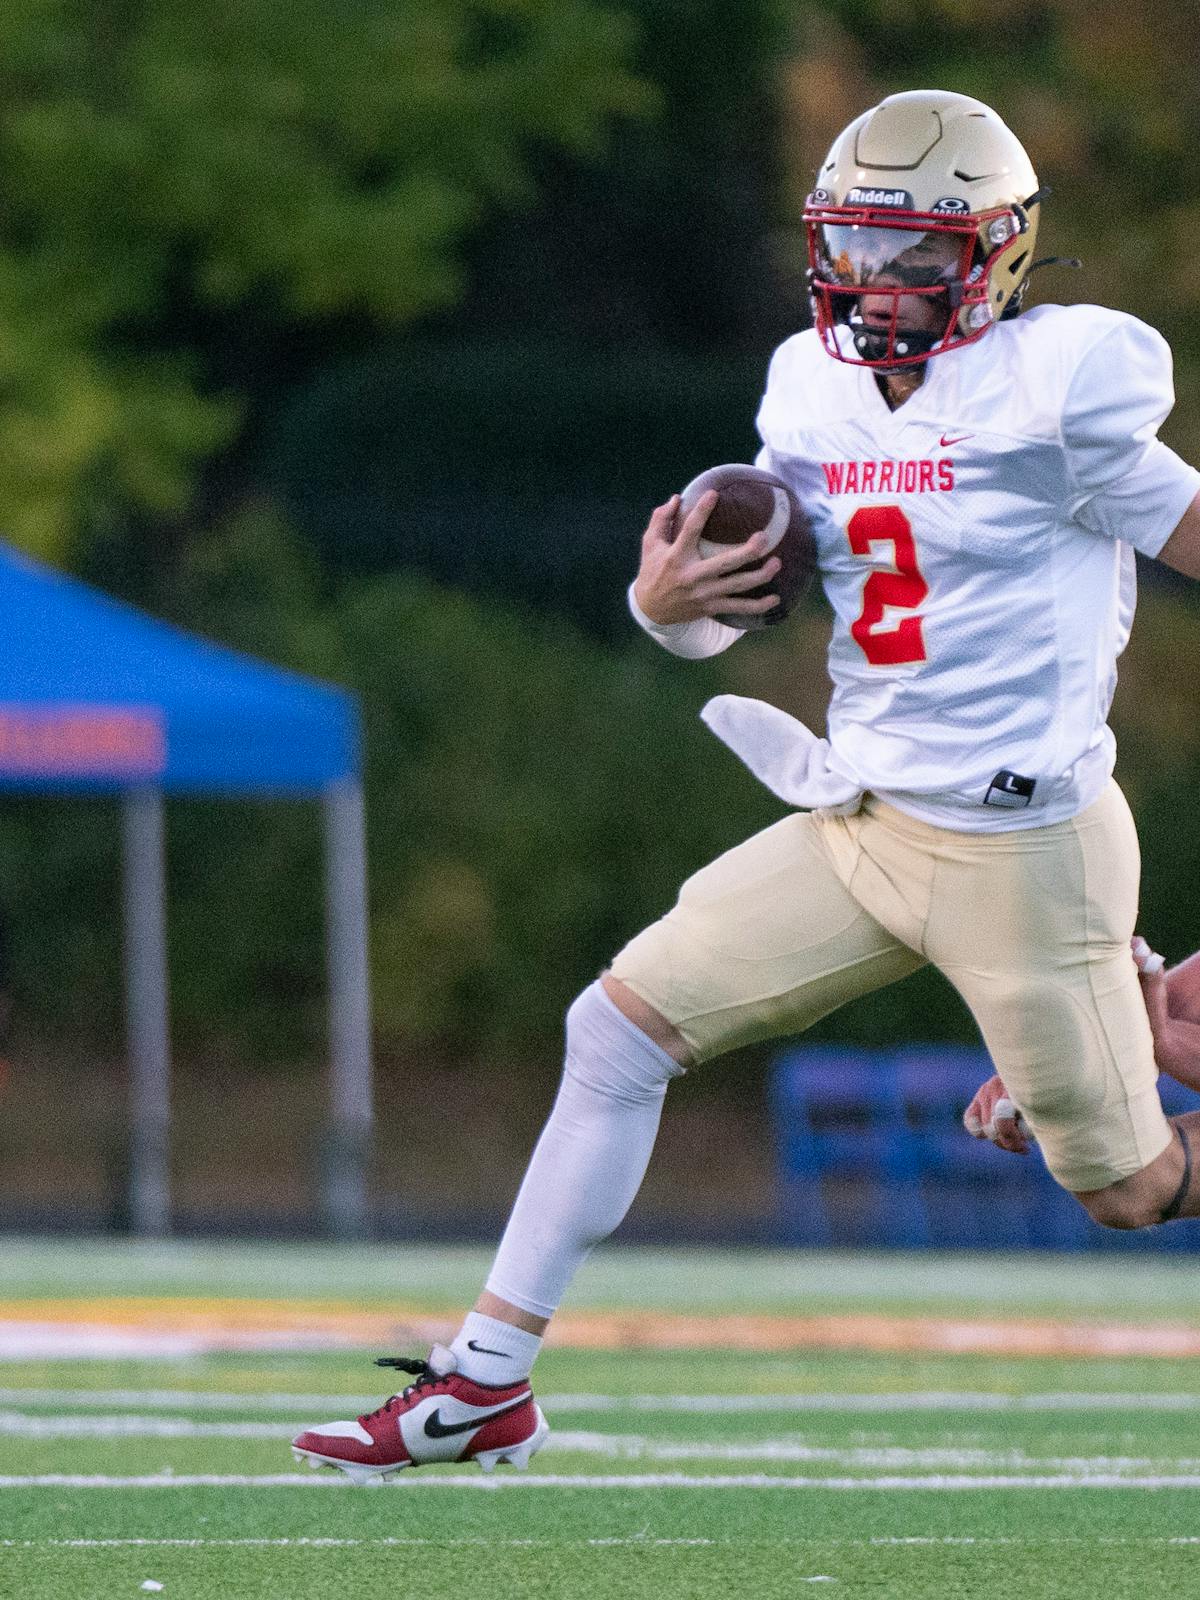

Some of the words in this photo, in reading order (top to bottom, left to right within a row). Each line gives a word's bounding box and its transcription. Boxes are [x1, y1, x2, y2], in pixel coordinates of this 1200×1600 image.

[850, 188, 906, 205] Riddell
[821, 458, 955, 494] WARRIORS
[845, 503, 929, 667] 2
[1005, 775, 1018, 791] L
